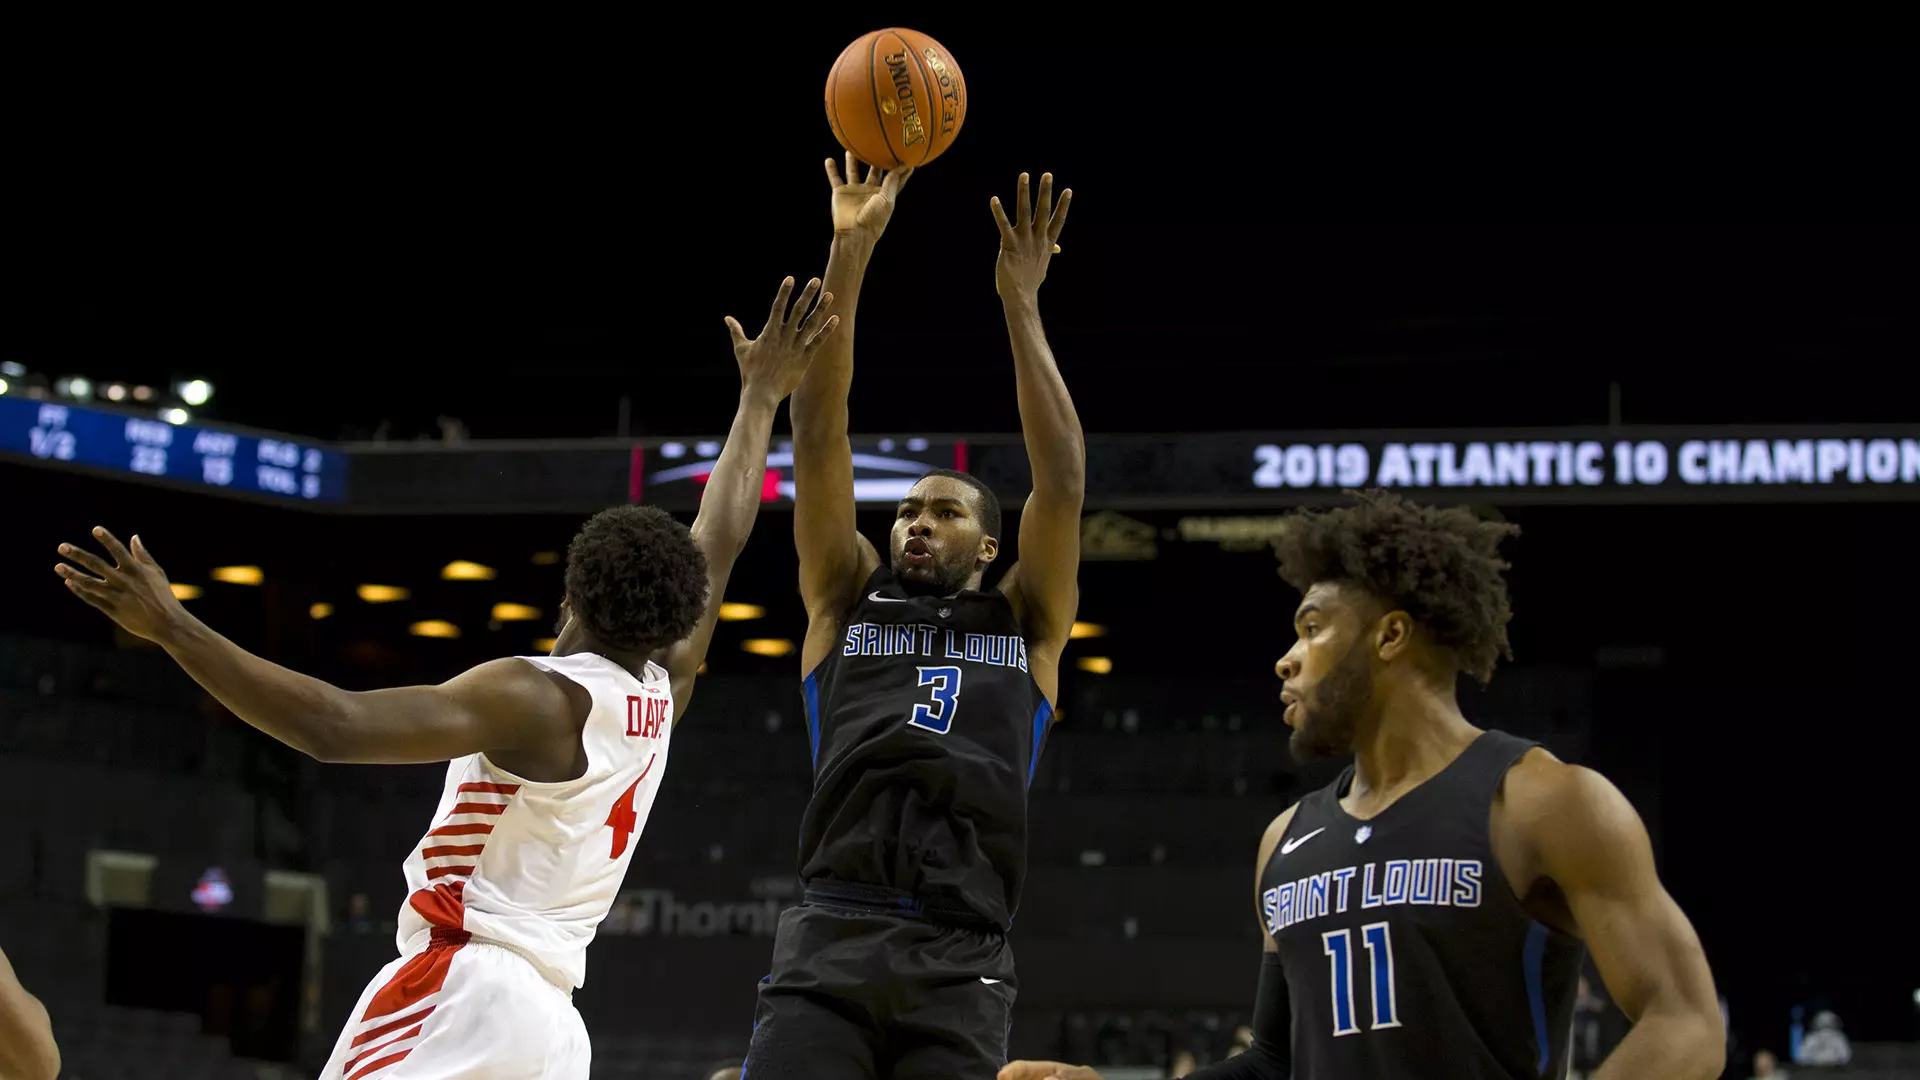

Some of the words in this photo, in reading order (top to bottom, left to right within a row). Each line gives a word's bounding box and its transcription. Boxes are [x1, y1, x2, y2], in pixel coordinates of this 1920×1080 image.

[883, 49, 926, 147] SPALDING
[1251, 443, 1369, 489] 2019
[1376, 440, 1605, 487] ATLANTIC
[1612, 440, 1669, 486] 10
[843, 622, 938, 657] SAINT
[944, 629, 1028, 673] LOUIS
[907, 665, 963, 735] 3
[605, 753, 656, 859] 4
[1263, 866, 1357, 935] SAINT
[1361, 858, 1483, 908] LOUIS
[1321, 921, 1403, 1037] 11
